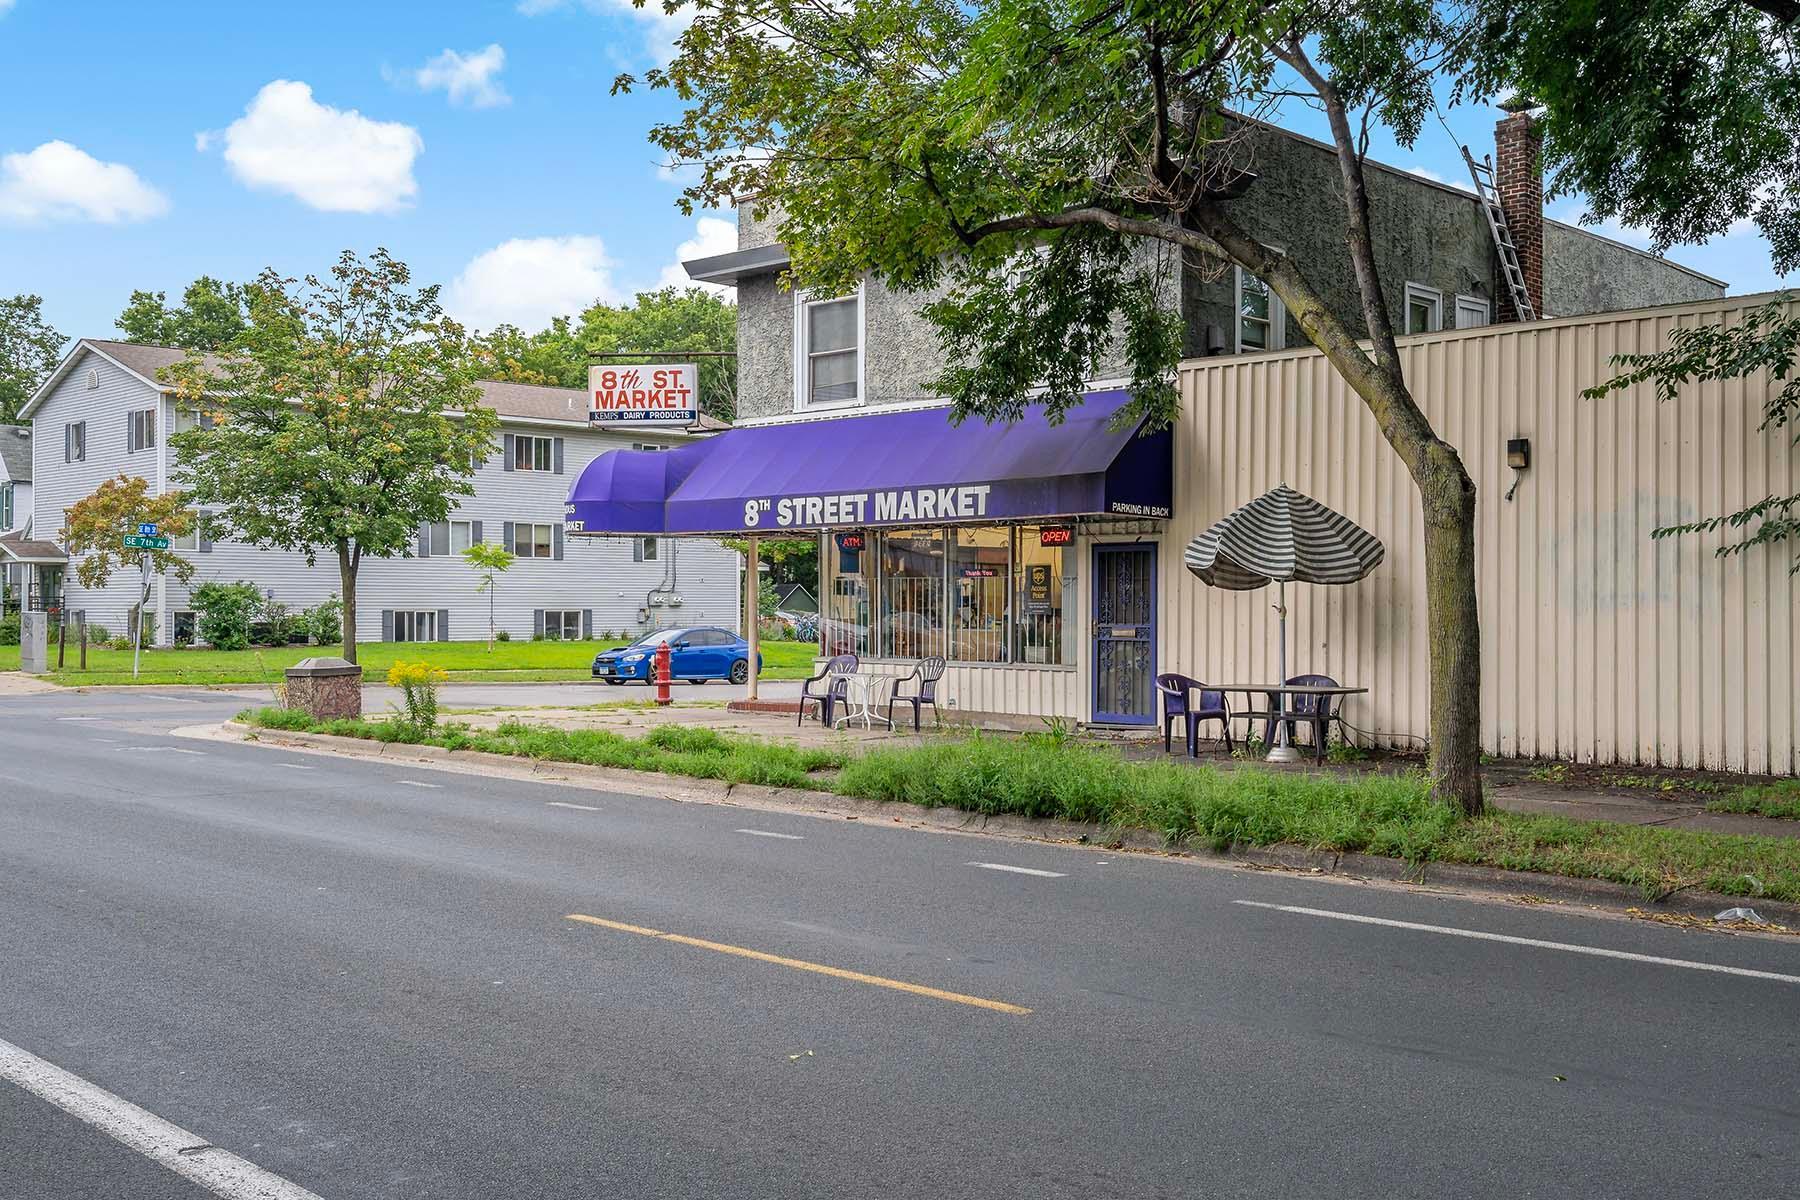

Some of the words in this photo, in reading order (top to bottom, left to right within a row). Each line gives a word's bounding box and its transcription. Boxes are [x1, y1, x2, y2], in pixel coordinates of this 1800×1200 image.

[601, 369, 643, 390] 8th
[653, 370, 684, 389] ST.
[595, 389, 691, 410] MARKET
[594, 411, 619, 420] KEMPS
[623, 411, 646, 419] DAIRY
[649, 410, 691, 419] PRODUCTS
[744, 499, 771, 527] 8TH
[776, 493, 868, 526] STREET
[874, 485, 991, 521] MARKET
[1112, 502, 1142, 515] PARKING
[1142, 506, 1151, 515] IN
[1151, 507, 1169, 517] BACK
[126, 537, 136, 545] SE
[140, 539, 154, 547] 7th
[156, 540, 167, 548] Av
[842, 536, 860, 547] ATM
[1041, 530, 1071, 543] OPEN
